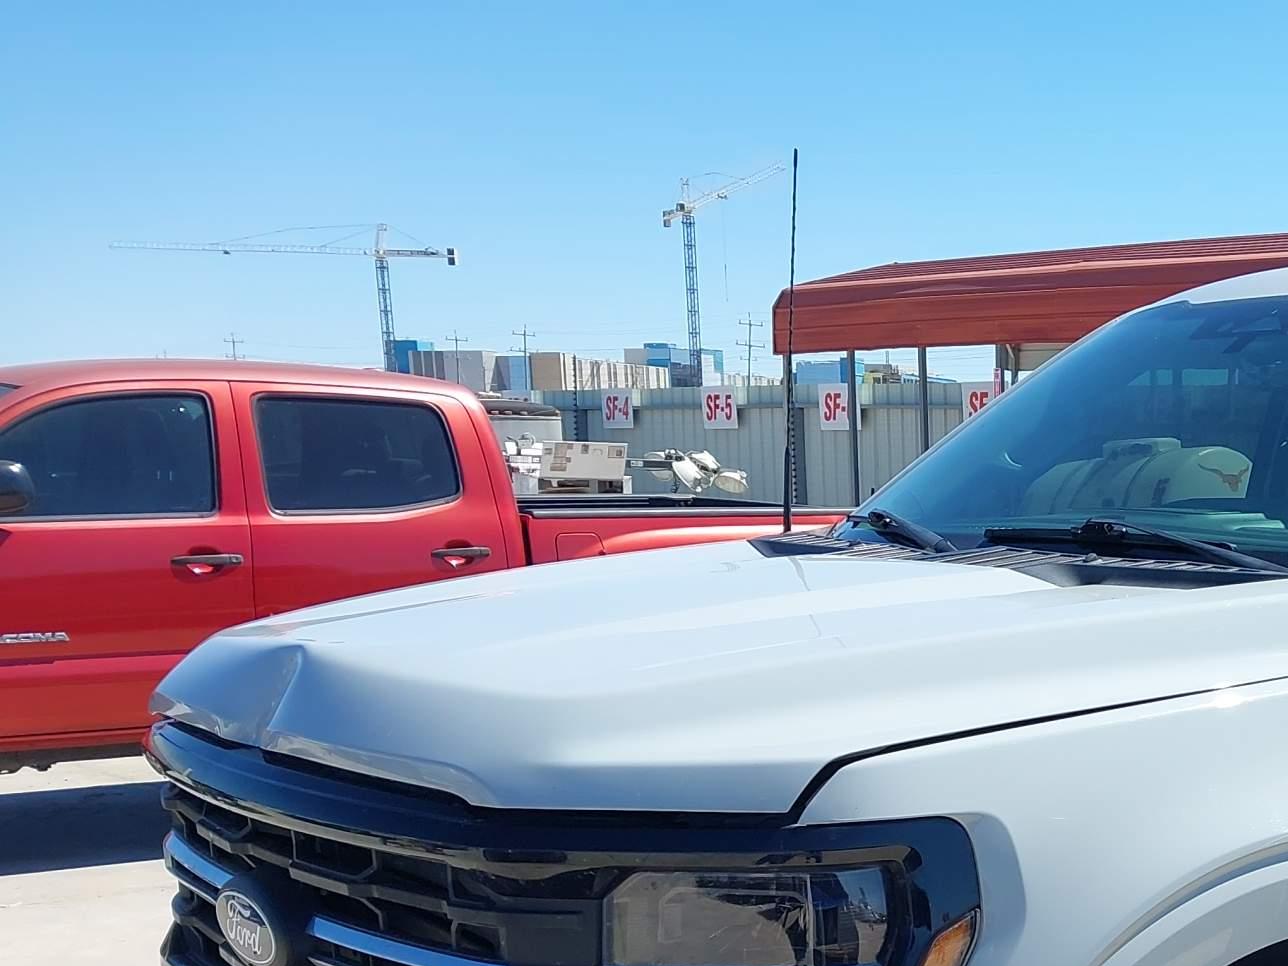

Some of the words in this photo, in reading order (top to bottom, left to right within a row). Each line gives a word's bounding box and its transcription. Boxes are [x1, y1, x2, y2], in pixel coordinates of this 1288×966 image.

[605, 395, 629, 421] SF-4
[705, 394, 733, 421] SF-5
[823, 392, 850, 422] SF-
[0, 631, 70, 644] COMA
[226, 899, 263, 955] Ford
